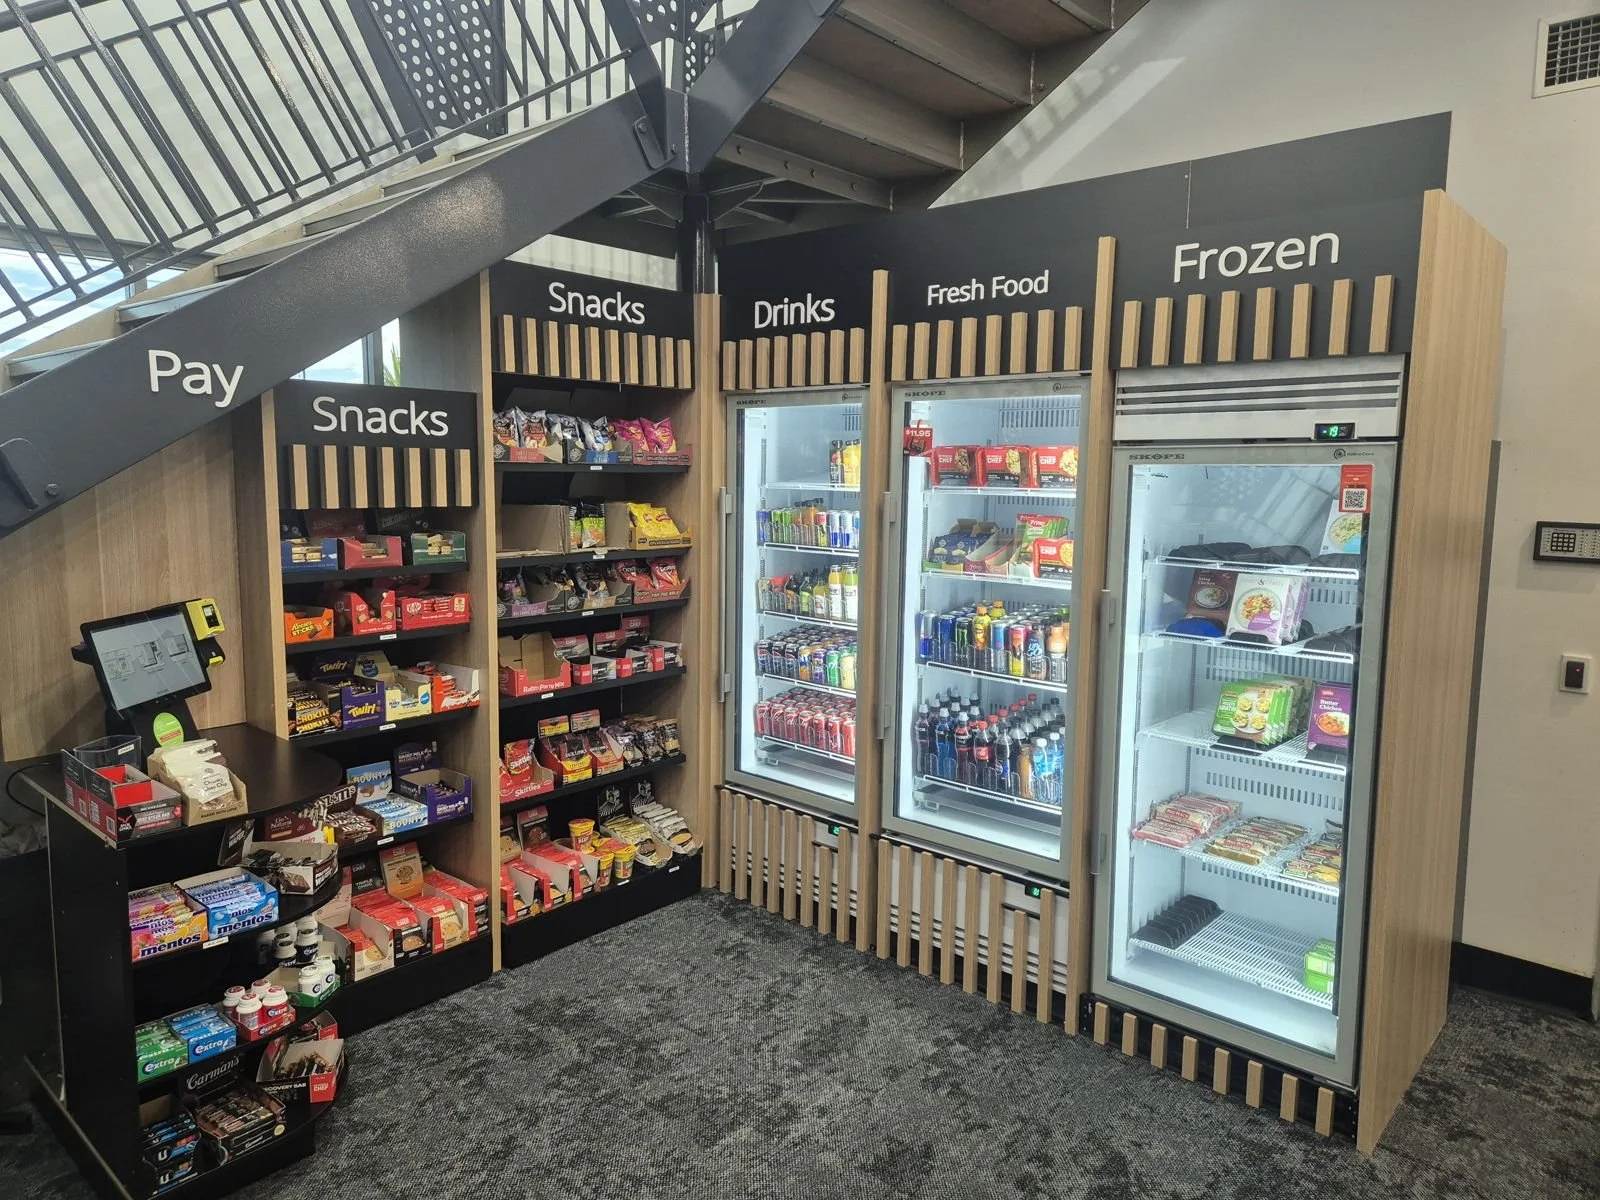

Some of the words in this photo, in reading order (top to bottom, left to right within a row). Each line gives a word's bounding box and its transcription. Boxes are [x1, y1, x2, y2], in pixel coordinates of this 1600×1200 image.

[1173, 231, 1340, 284] Frozen
[927, 277, 985, 306] Fresh
[991, 269, 1050, 298] Food
[548, 281, 646, 325] Snacks
[754, 293, 836, 329] Drinks
[148, 349, 244, 408] Pay
[904, 390, 946, 398] SKOPE
[312, 396, 449, 437] Snacks
[905, 429, 931, 438] $11.95
[1129, 453, 1185, 461] SKOPE
[320, 660, 348, 673] Twirl
[348, 702, 376, 718] Twirl
[1319, 704, 1343, 712] Chicken
[353, 769, 389, 784] BOUNTY
[514, 783, 541, 797] Skittles
[270, 820, 292, 829] Natural
[389, 813, 427, 830] BOUNTY
[355, 878, 373, 887] TRIPLE
[216, 912, 273, 935] mentos
[140, 933, 201, 957] mentos
[267, 1006, 288, 1018] extra
[258, 1023, 277, 1035] extra
[195, 1040, 223, 1054] extra
[144, 1058, 175, 1073] extra
[187, 1055, 240, 1090] Carman's
